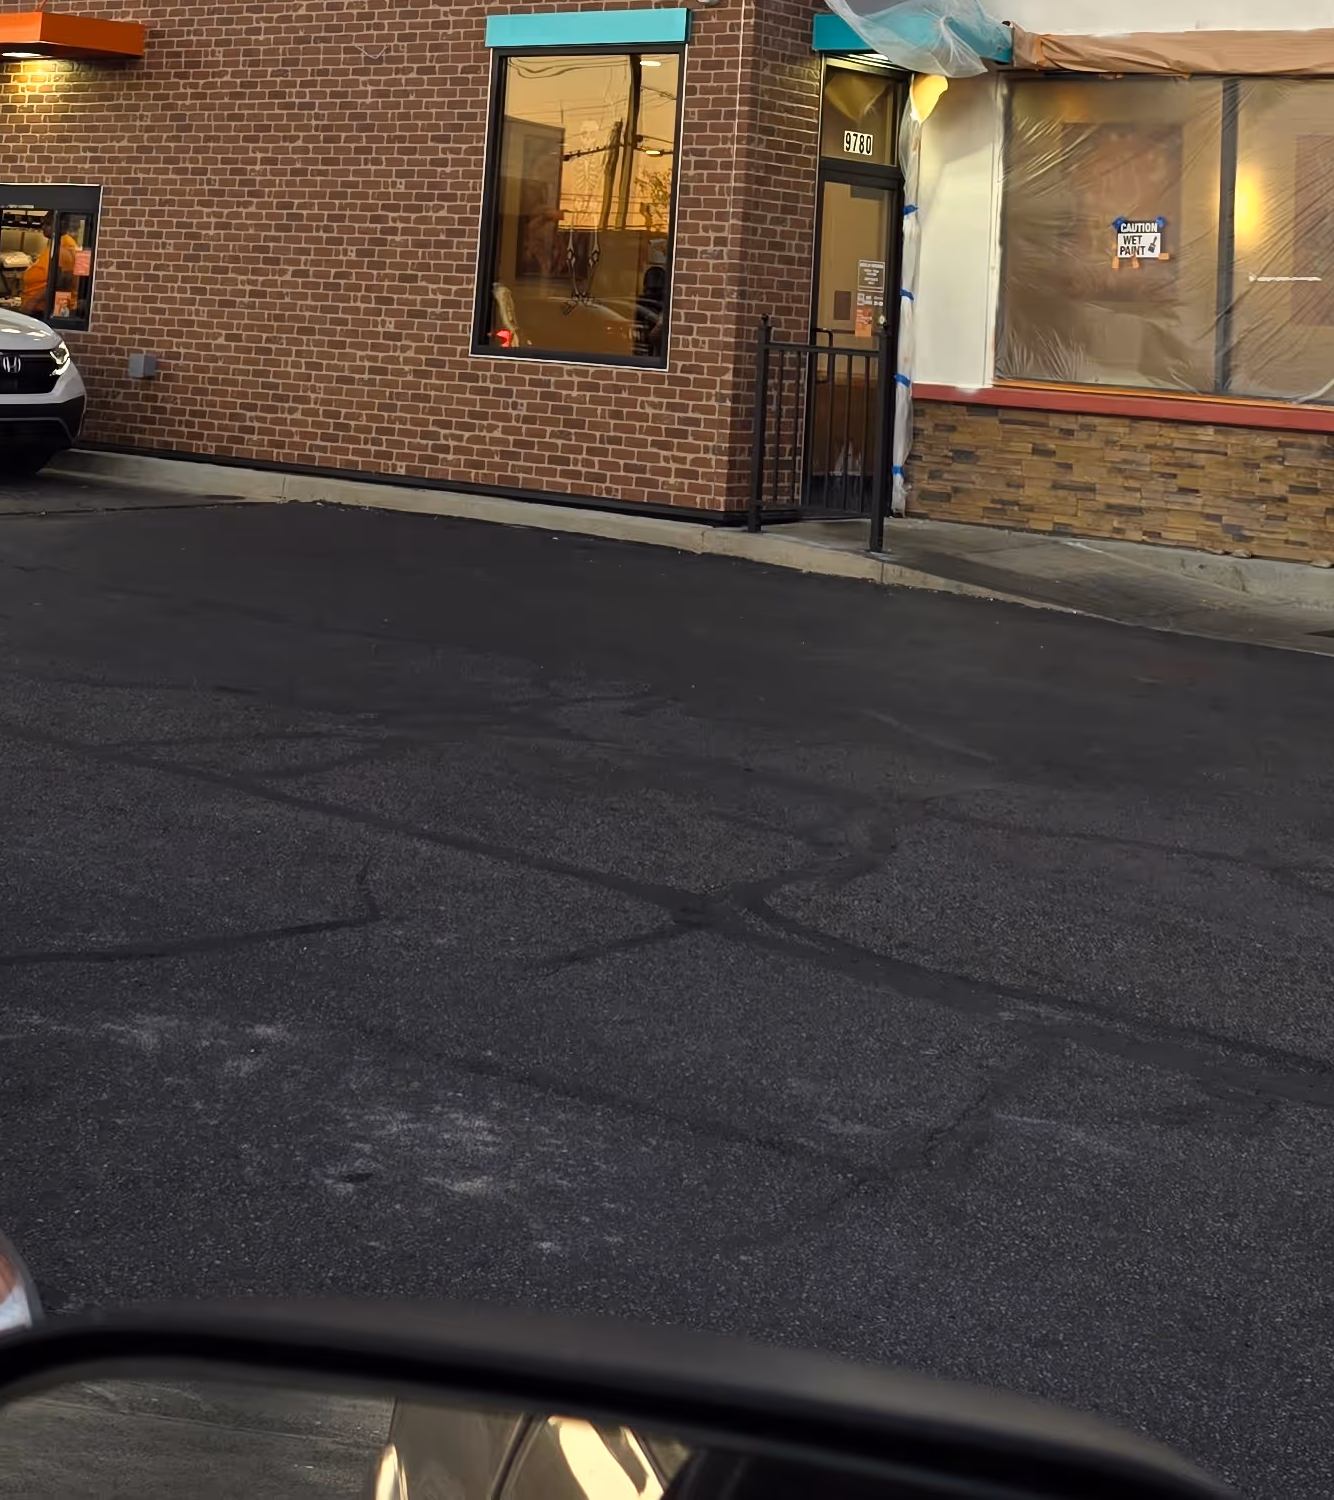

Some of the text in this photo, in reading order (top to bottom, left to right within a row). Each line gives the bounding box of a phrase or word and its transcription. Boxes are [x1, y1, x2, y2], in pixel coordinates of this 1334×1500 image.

[845, 132, 872, 154] 9780
[1121, 222, 1157, 232] CAUTION
[1123, 235, 1142, 245] WET
[1120, 246, 1146, 255] PAINT
